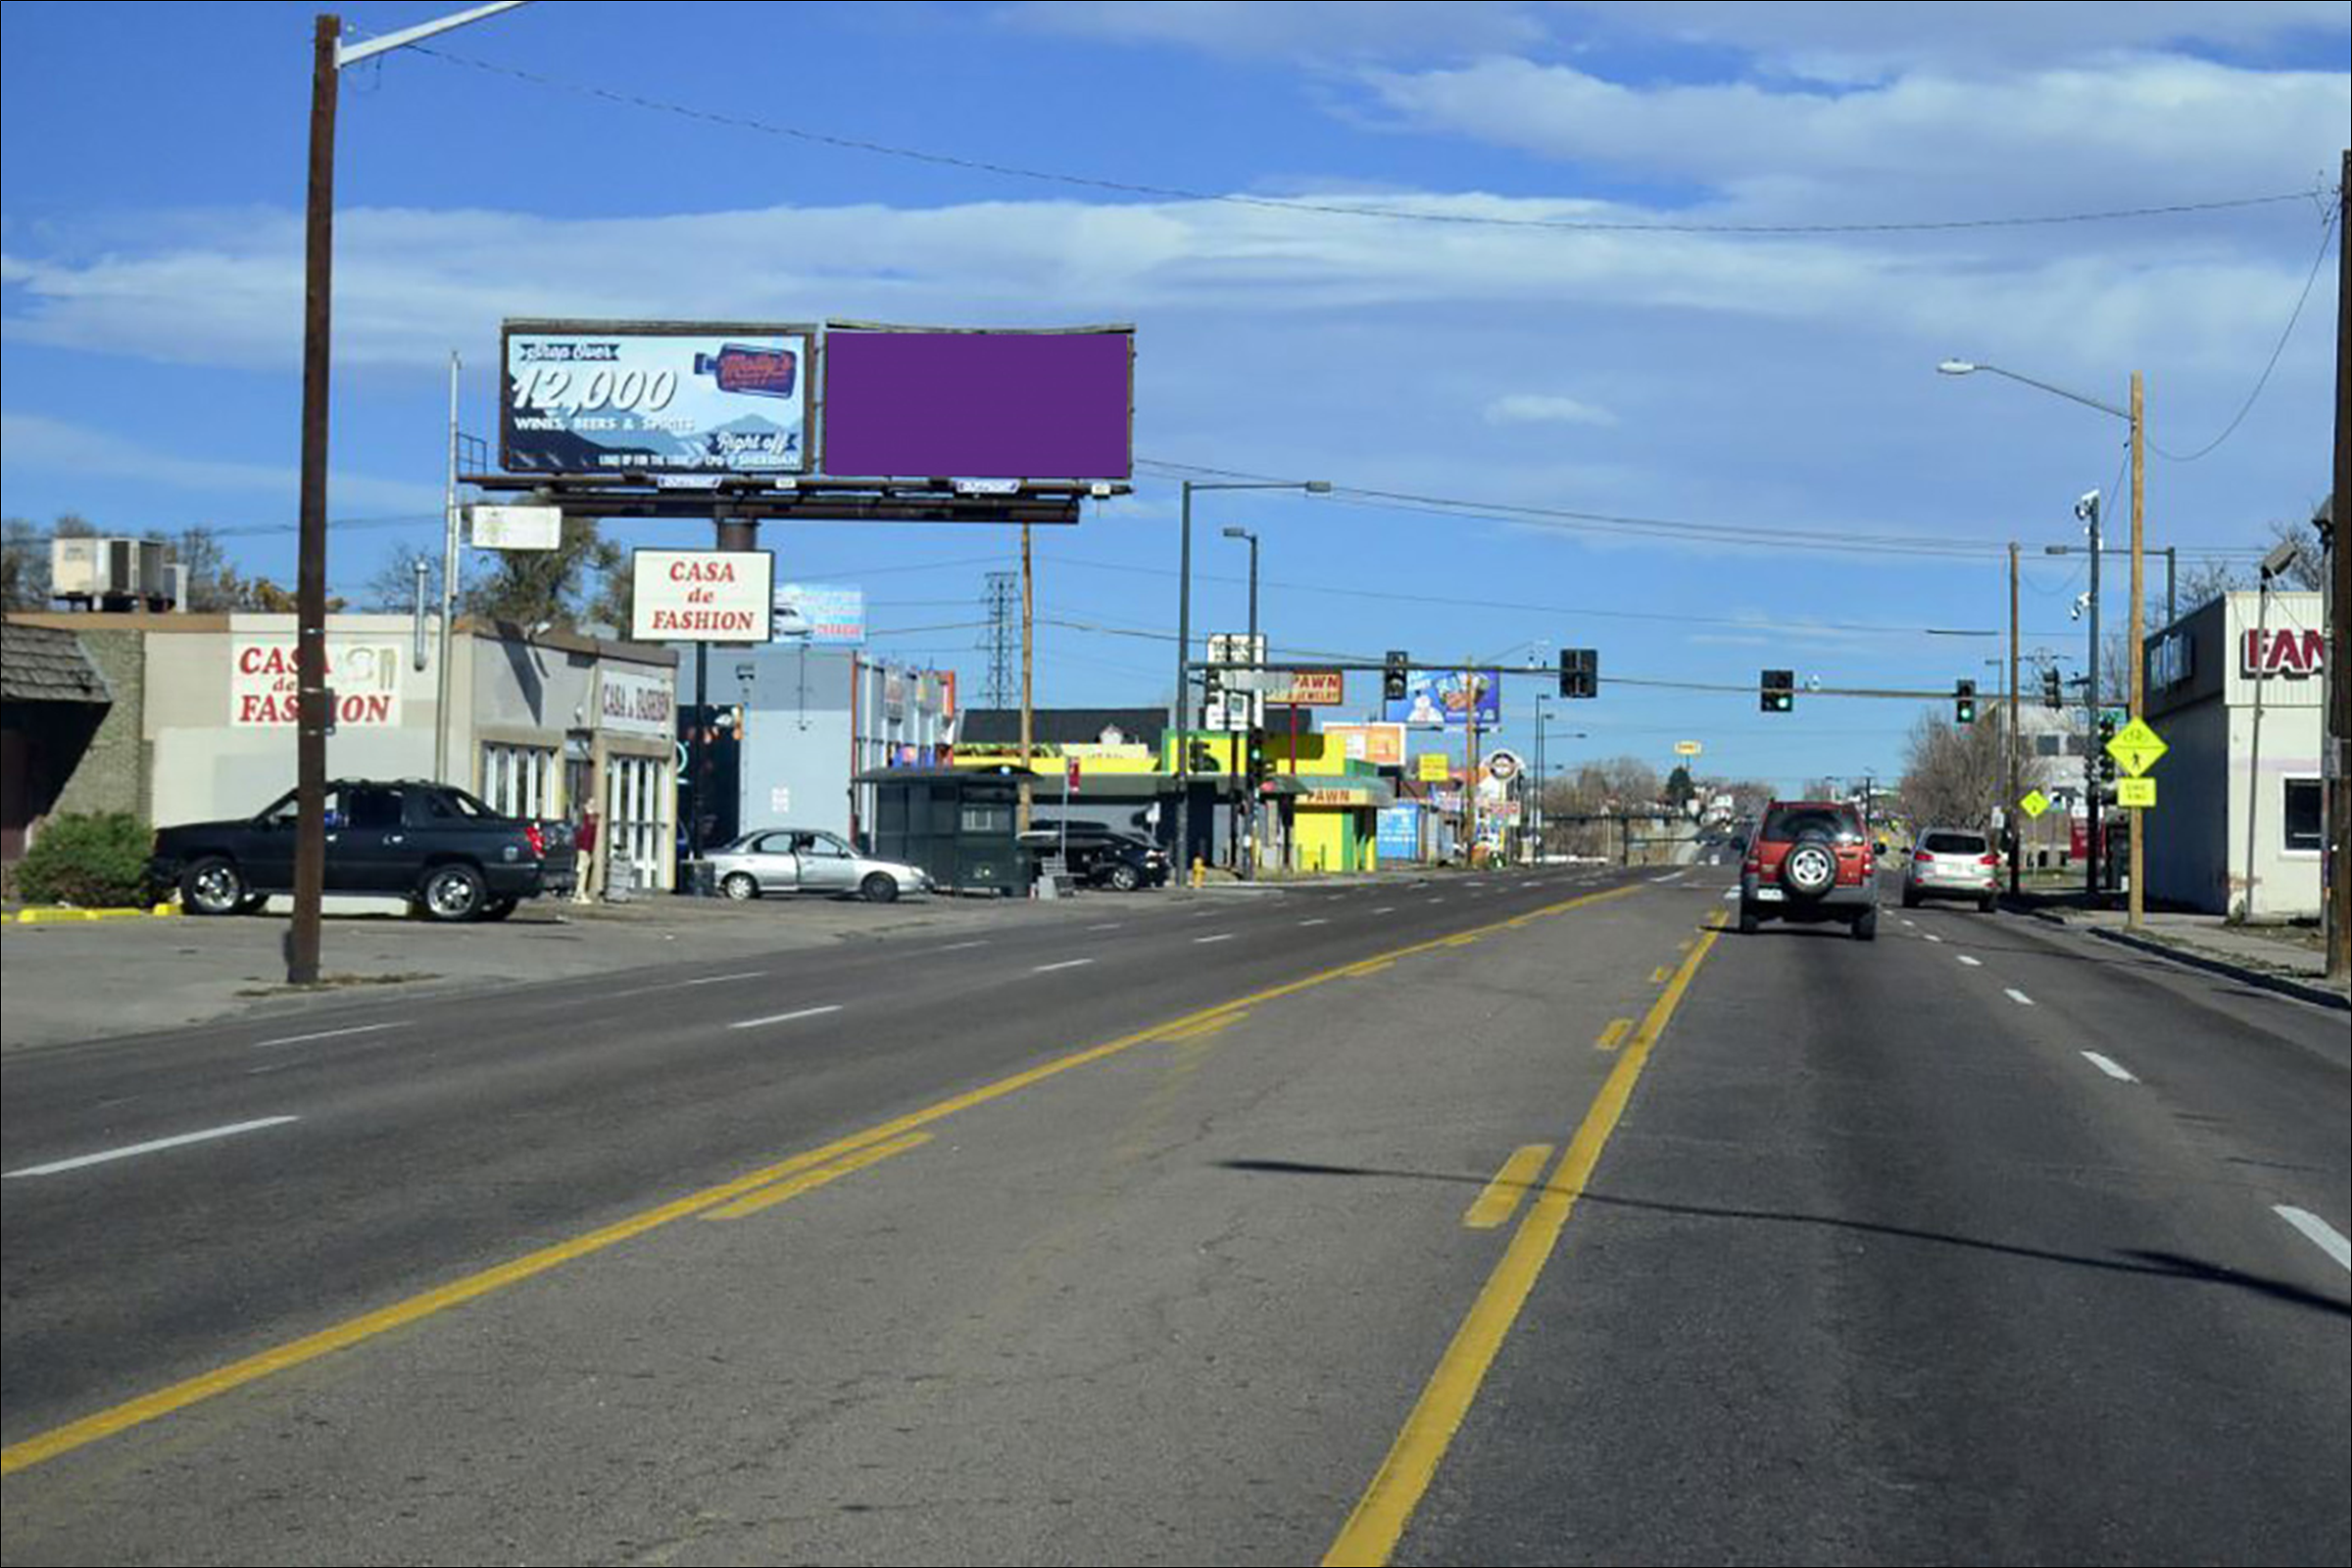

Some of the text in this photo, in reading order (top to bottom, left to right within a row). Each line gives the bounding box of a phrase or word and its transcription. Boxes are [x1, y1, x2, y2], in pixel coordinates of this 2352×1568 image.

[512, 368, 678, 418] 12,000
[514, 416, 566, 431] WINES,
[573, 416, 616, 430] BEERS
[717, 431, 790, 456] Right off
[669, 562, 735, 582] CASA
[688, 588, 713, 604] de
[652, 611, 755, 631] FASHION
[239, 647, 331, 674] CAS
[272, 677, 297, 692] de
[1291, 673, 1339, 688] PAWN
[1306, 789, 1350, 802] PAWN
